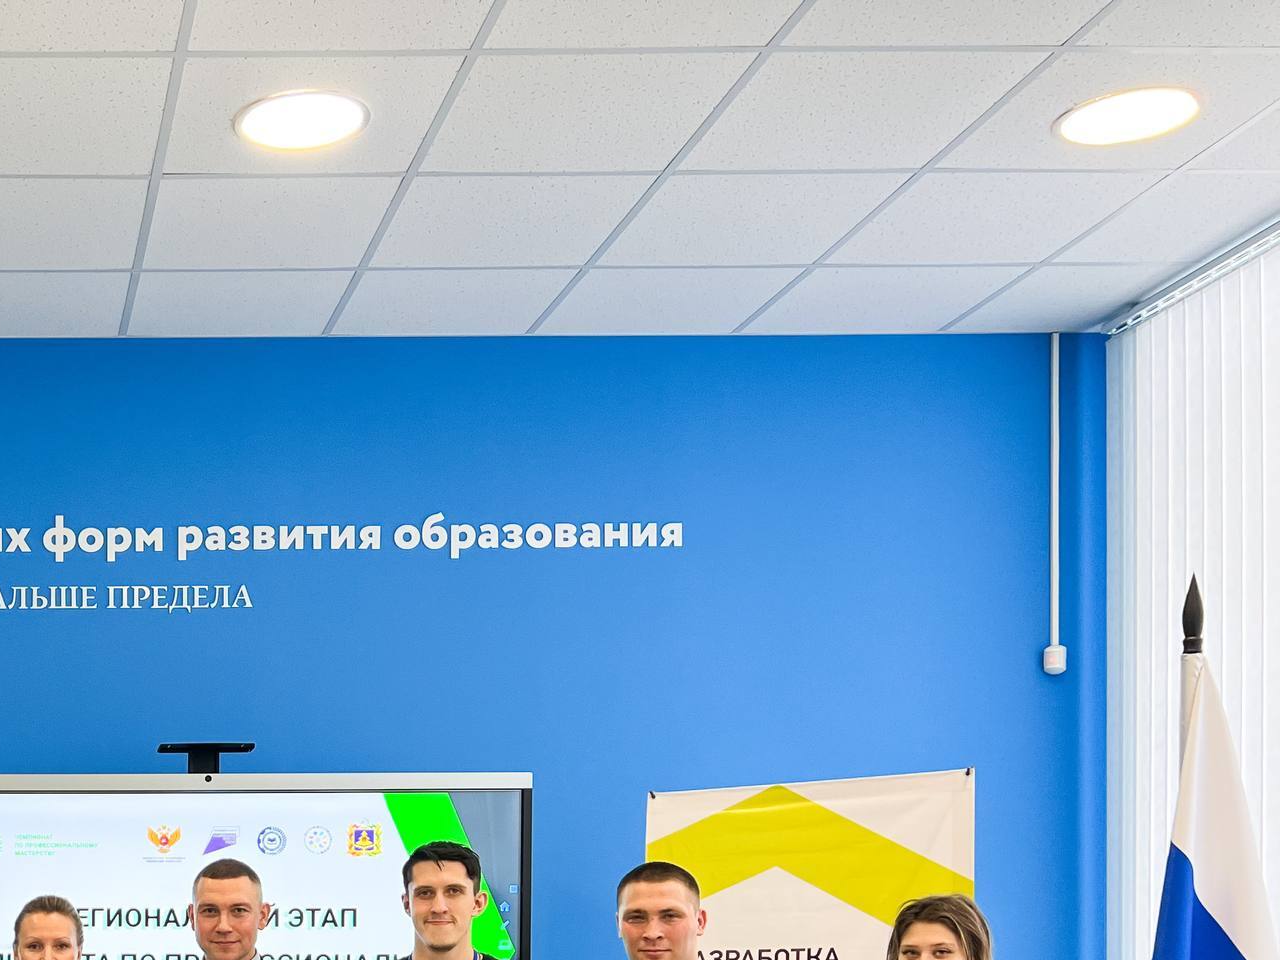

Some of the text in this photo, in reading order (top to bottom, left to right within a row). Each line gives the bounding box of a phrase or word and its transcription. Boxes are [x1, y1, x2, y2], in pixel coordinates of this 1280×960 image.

[43, 515, 164, 563] форм
[177, 525, 381, 561] развития
[393, 512, 683, 559] образования
[106, 585, 253, 614] ПРЕДЕЛА
[288, 907, 358, 928] ЭТАП
